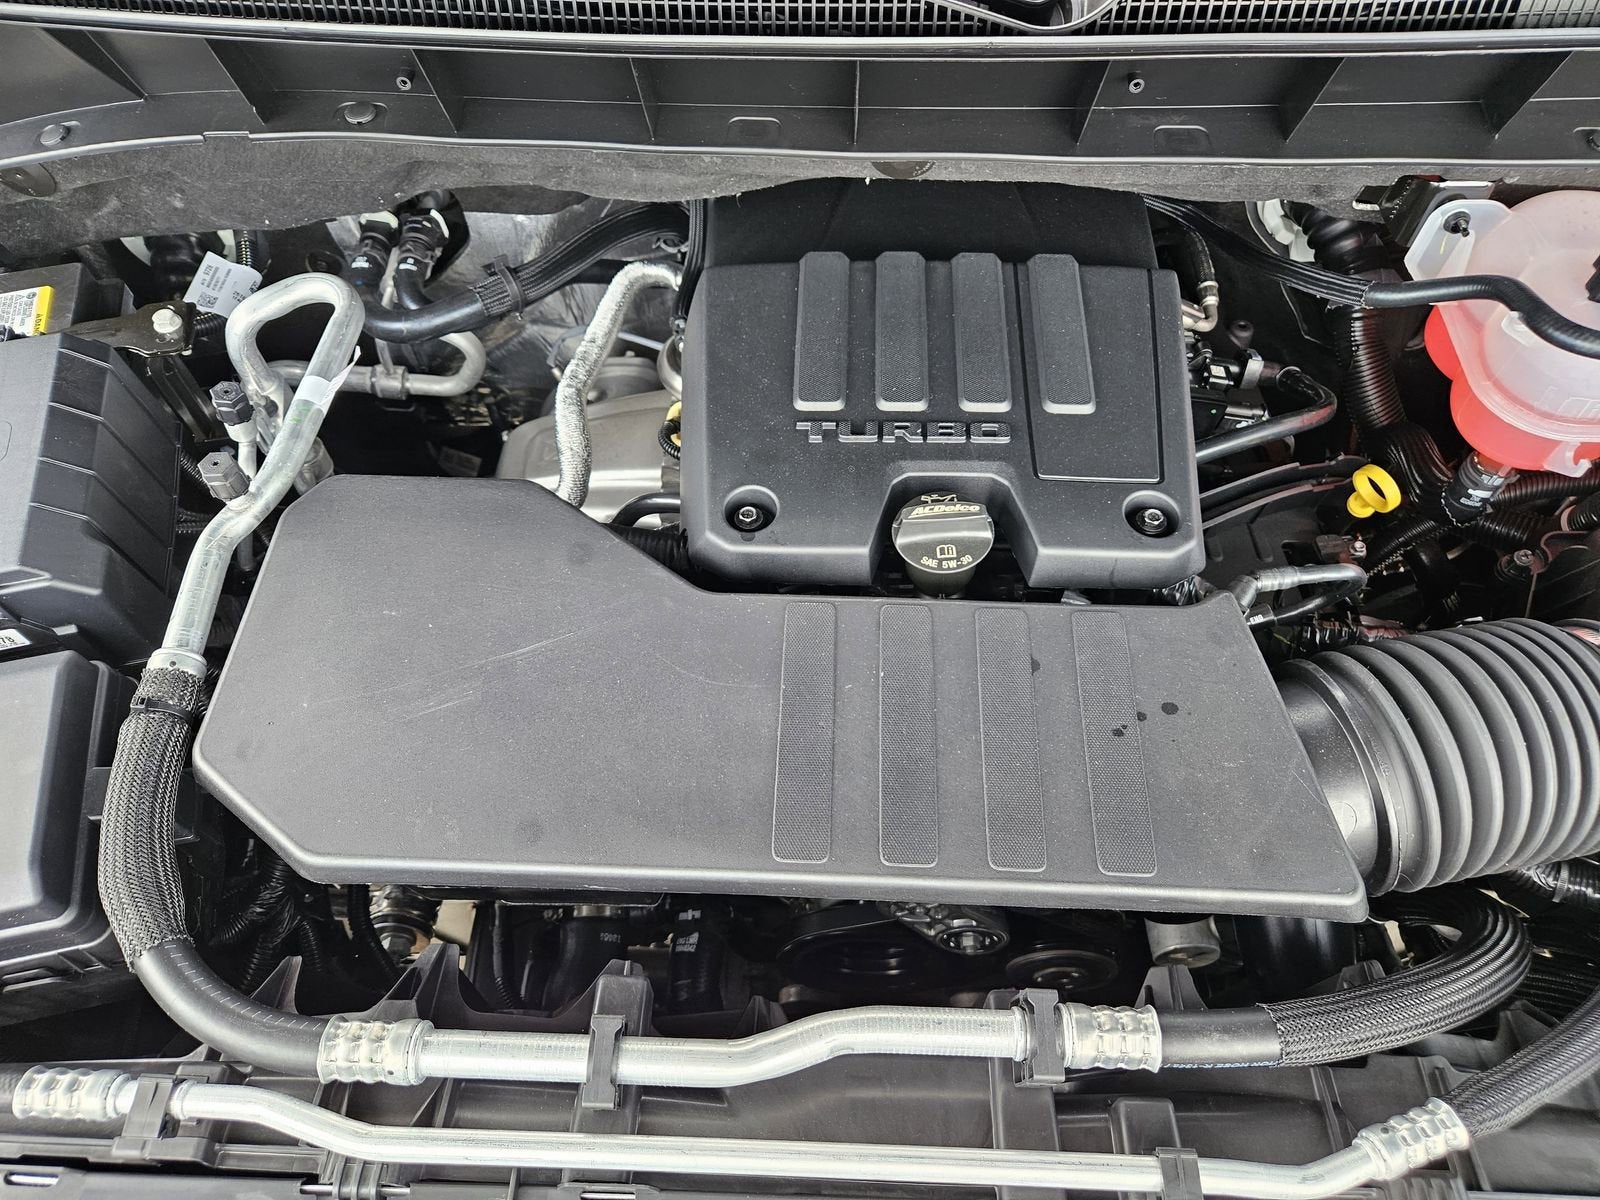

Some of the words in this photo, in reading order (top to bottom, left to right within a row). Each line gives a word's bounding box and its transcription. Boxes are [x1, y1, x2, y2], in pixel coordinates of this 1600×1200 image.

[796, 421, 1011, 443] TURBO
[908, 504, 981, 518] ACDelco
[920, 556, 938, 568] SAE
[942, 554, 973, 569] 5W-30
